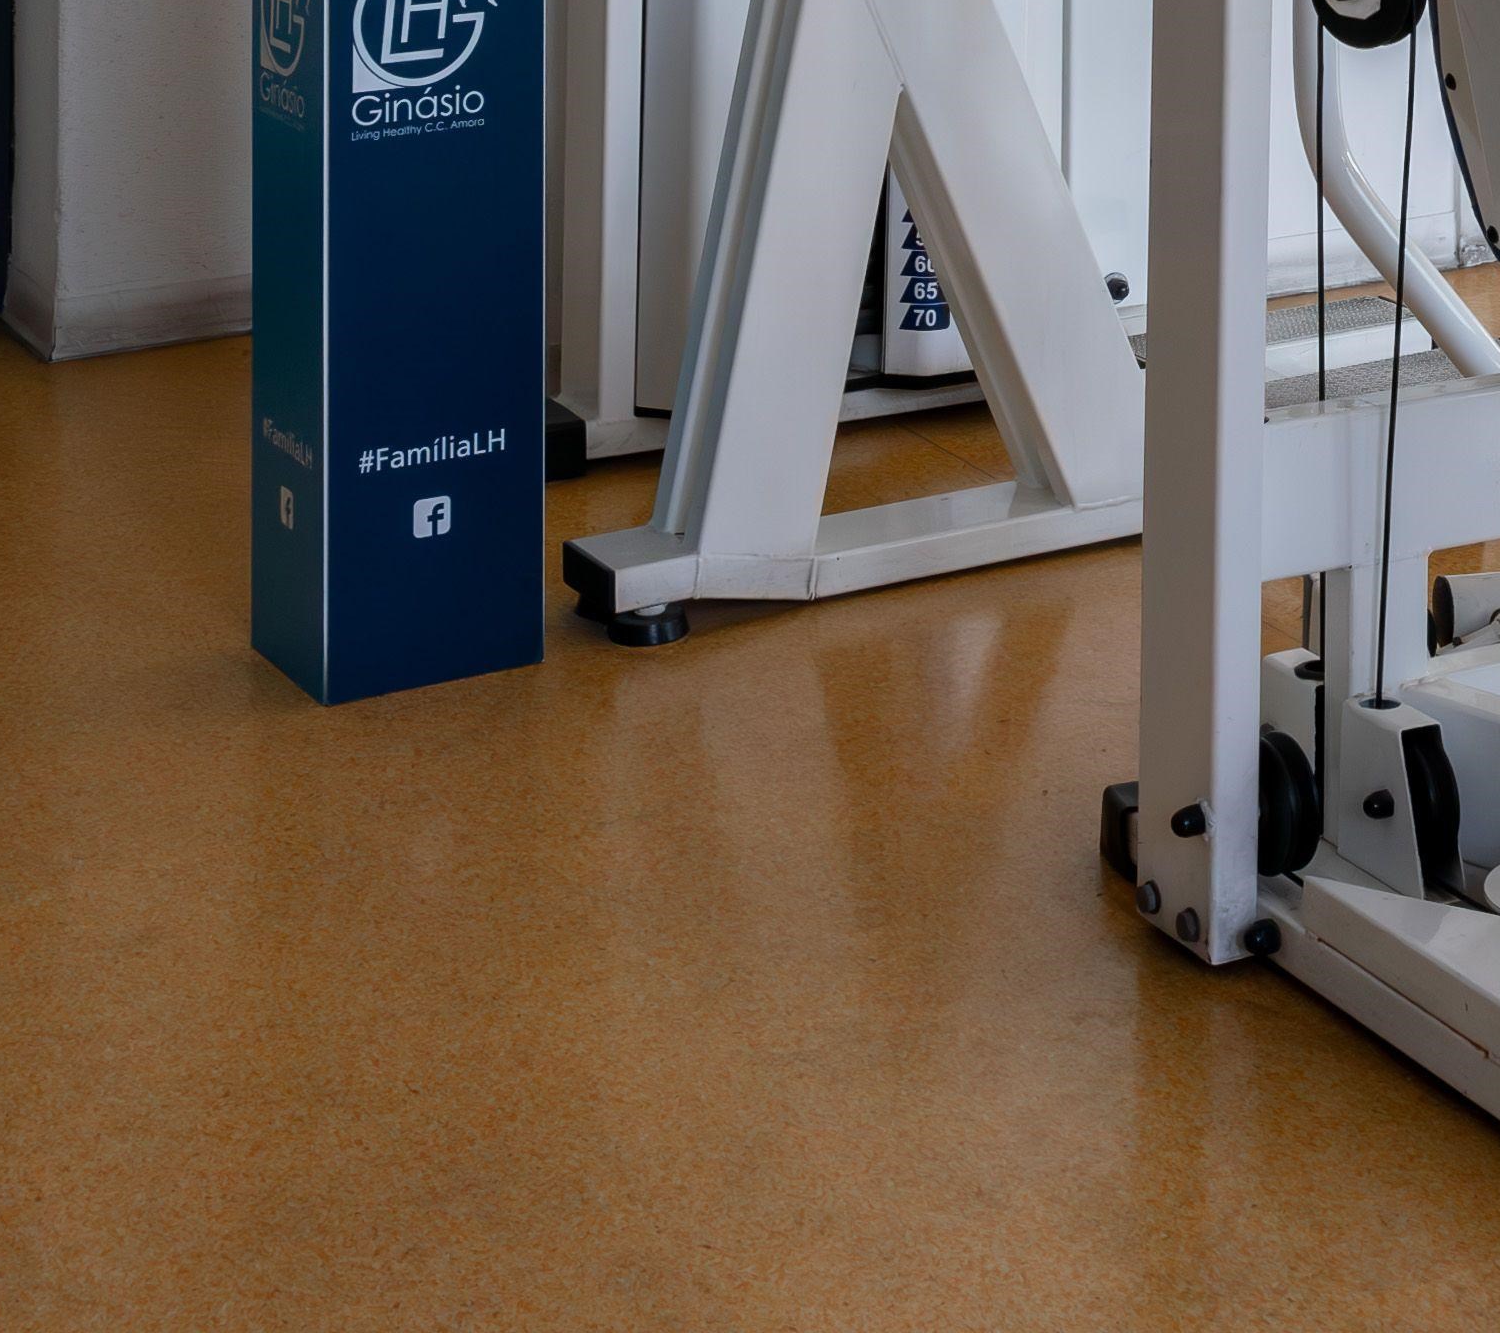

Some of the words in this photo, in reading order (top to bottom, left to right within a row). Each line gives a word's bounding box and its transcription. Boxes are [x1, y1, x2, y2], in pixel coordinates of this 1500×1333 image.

[352, 85, 485, 126] Ginásio
[351, 129, 380, 141] Living
[383, 125, 422, 137] Healthy
[425, 121, 448, 132] C.C.
[451, 118, 485, 129] Amora
[914, 282, 938, 300] 65
[913, 309, 937, 327] 70
[358, 428, 506, 474] #FamíliaLH
